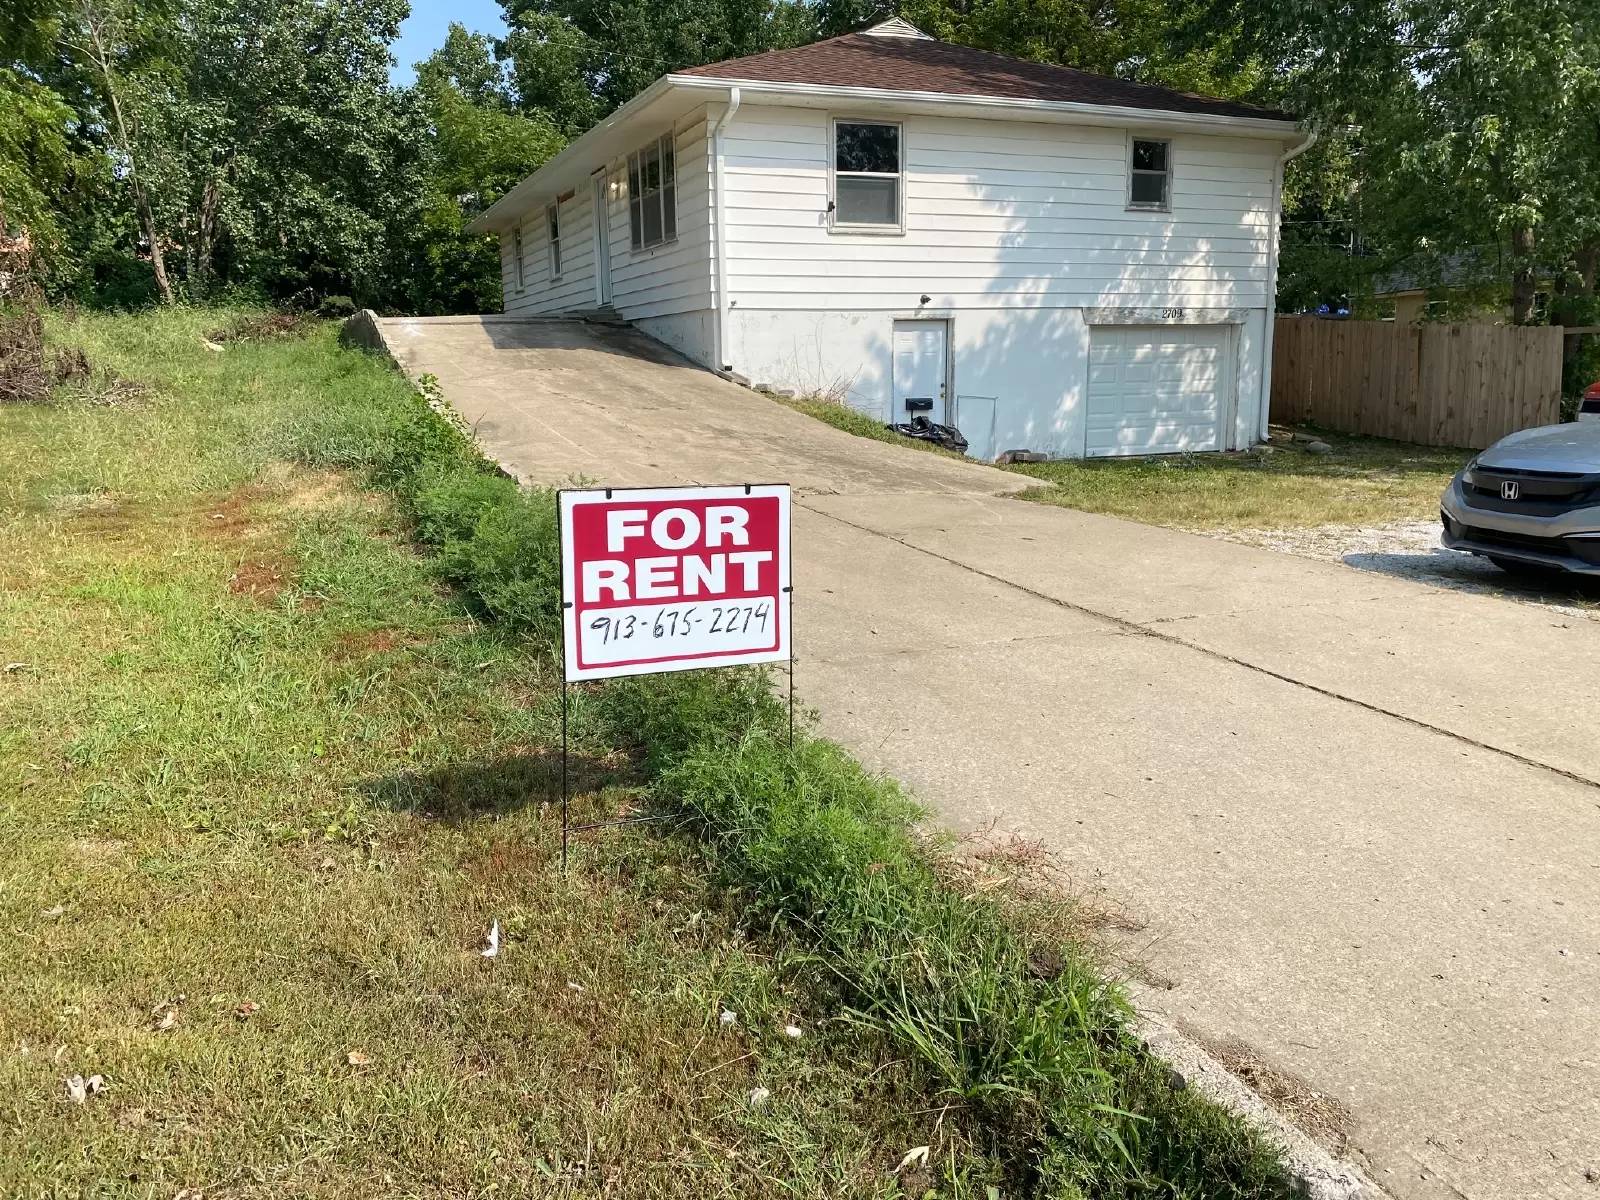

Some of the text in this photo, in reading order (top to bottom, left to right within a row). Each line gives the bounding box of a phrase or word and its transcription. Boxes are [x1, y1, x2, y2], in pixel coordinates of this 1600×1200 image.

[606, 505, 750, 552] FOR
[582, 550, 773, 603] RENT
[590, 602, 770, 645] 913-675-2274
